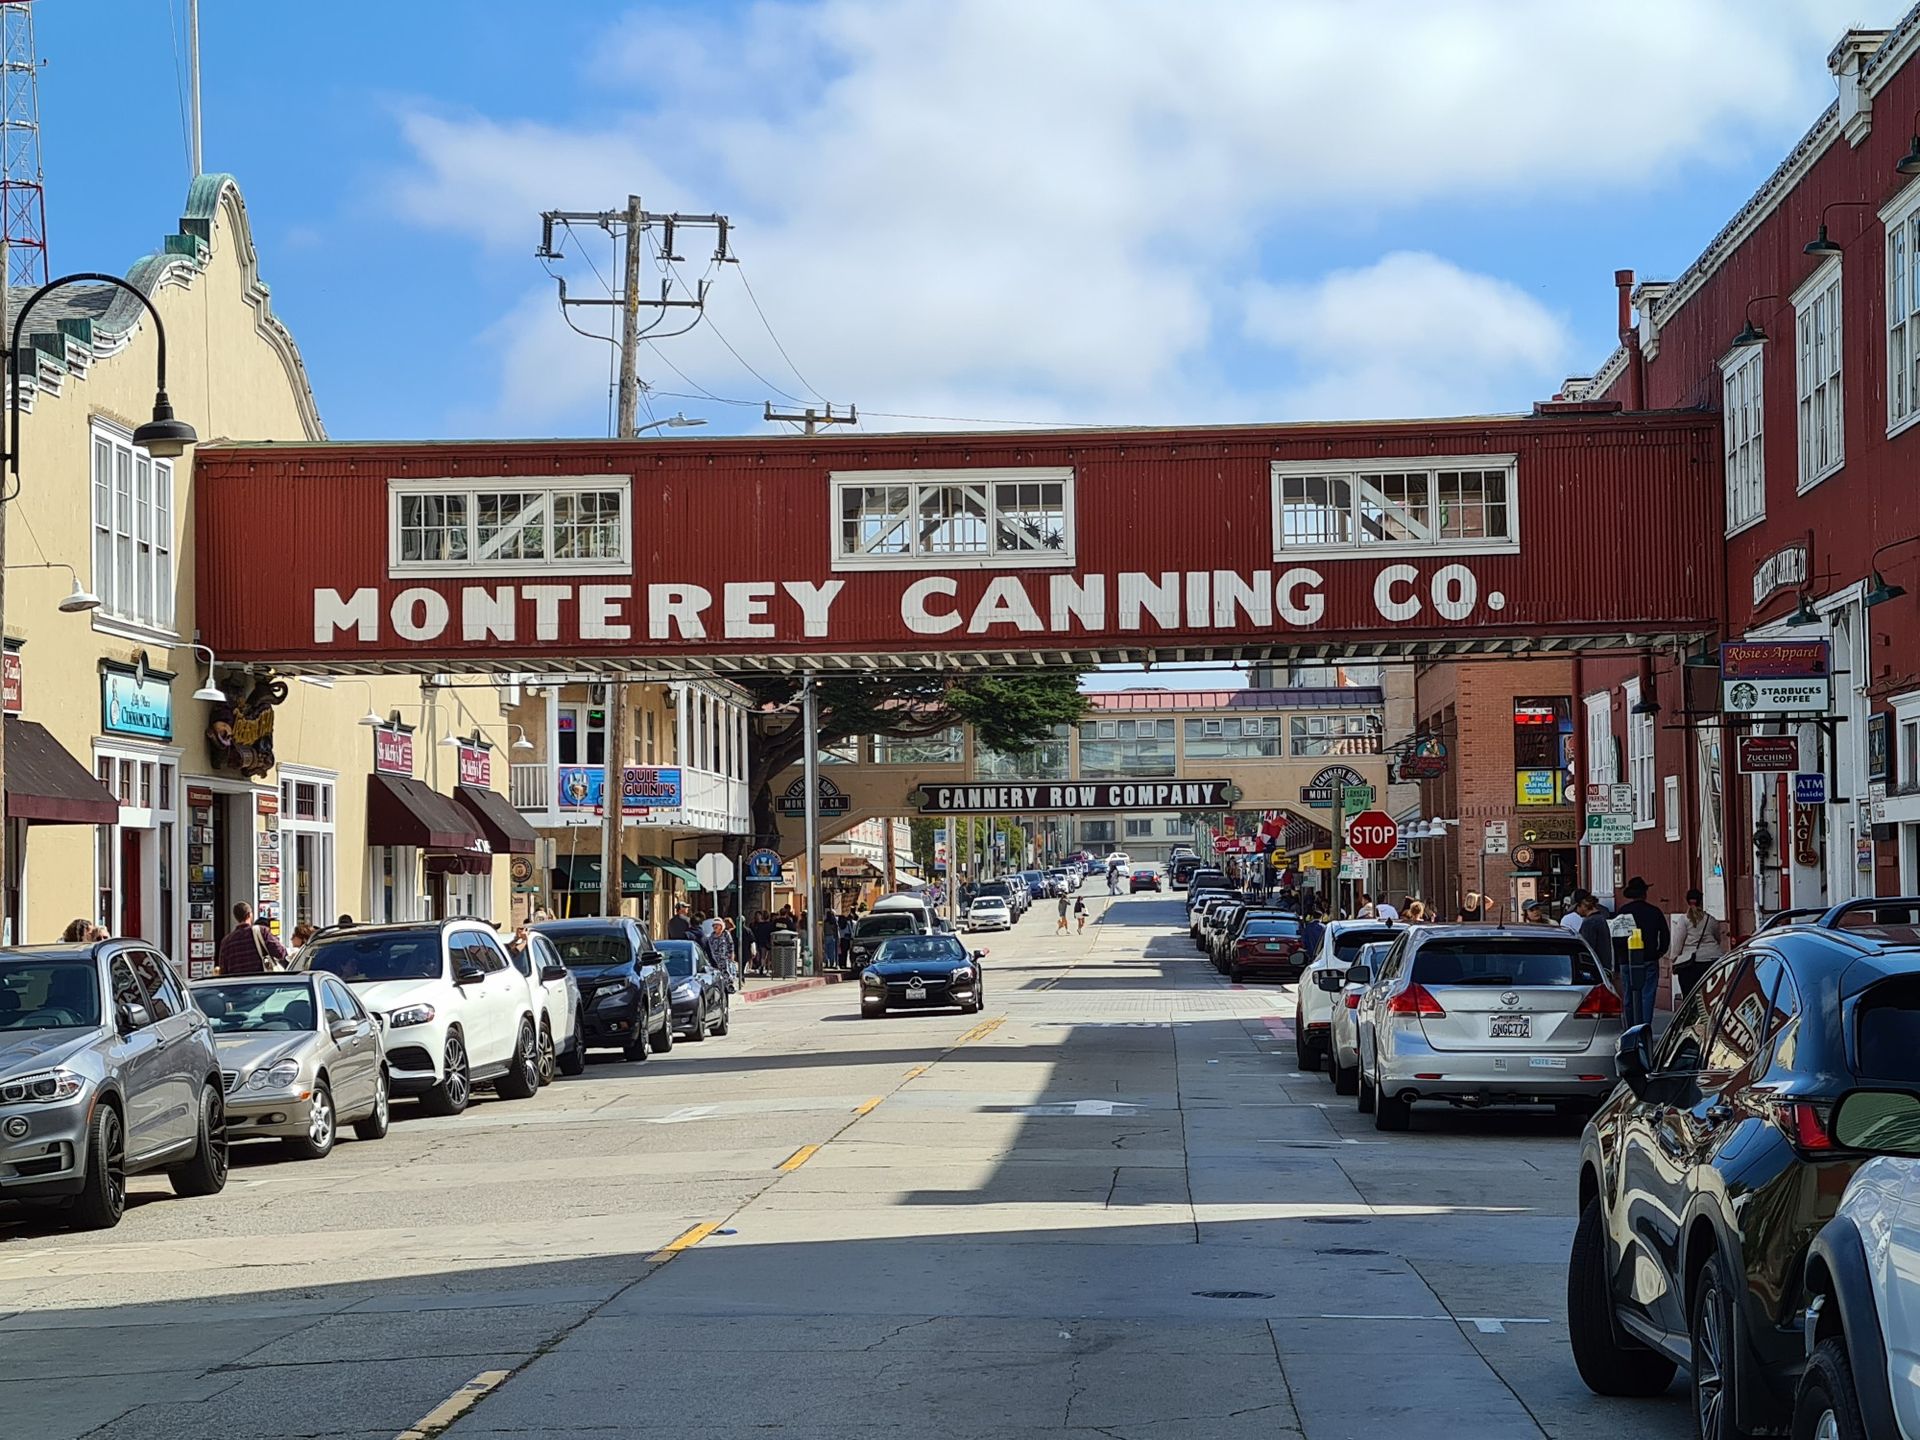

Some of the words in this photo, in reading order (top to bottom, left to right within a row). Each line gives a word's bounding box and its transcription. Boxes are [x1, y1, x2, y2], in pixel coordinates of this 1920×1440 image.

[313, 580, 846, 643] MONTEREY
[901, 568, 1325, 634] CANNING
[1373, 564, 1506, 621] CO.
[1728, 647, 1768, 661] Rosie's
[1771, 645, 1820, 661] Apparel
[1761, 687, 1821, 695] STARBUCKS
[1772, 695, 1811, 703] COFFEE
[623, 769, 659, 782] OUIE
[1346, 771, 1360, 786] ROW
[599, 782, 676, 796] GUINI'S
[1589, 786, 1598, 794] NO
[1797, 780, 1824, 789] ATM
[938, 788, 1038, 809] CANNERY
[1050, 787, 1096, 806] ROW
[1109, 784, 1215, 806] COMPANY
[1593, 816, 1599, 827] 2
[1352, 826, 1395, 844] STOP
[1540, 831, 1576, 840] ZONE
[1797, 803, 1812, 862] MAGIC
[1215, 840, 1230, 848] STOP
[580, 881, 602, 889] PEBBL
[1492, 1023, 1529, 1035] 6NGC772
